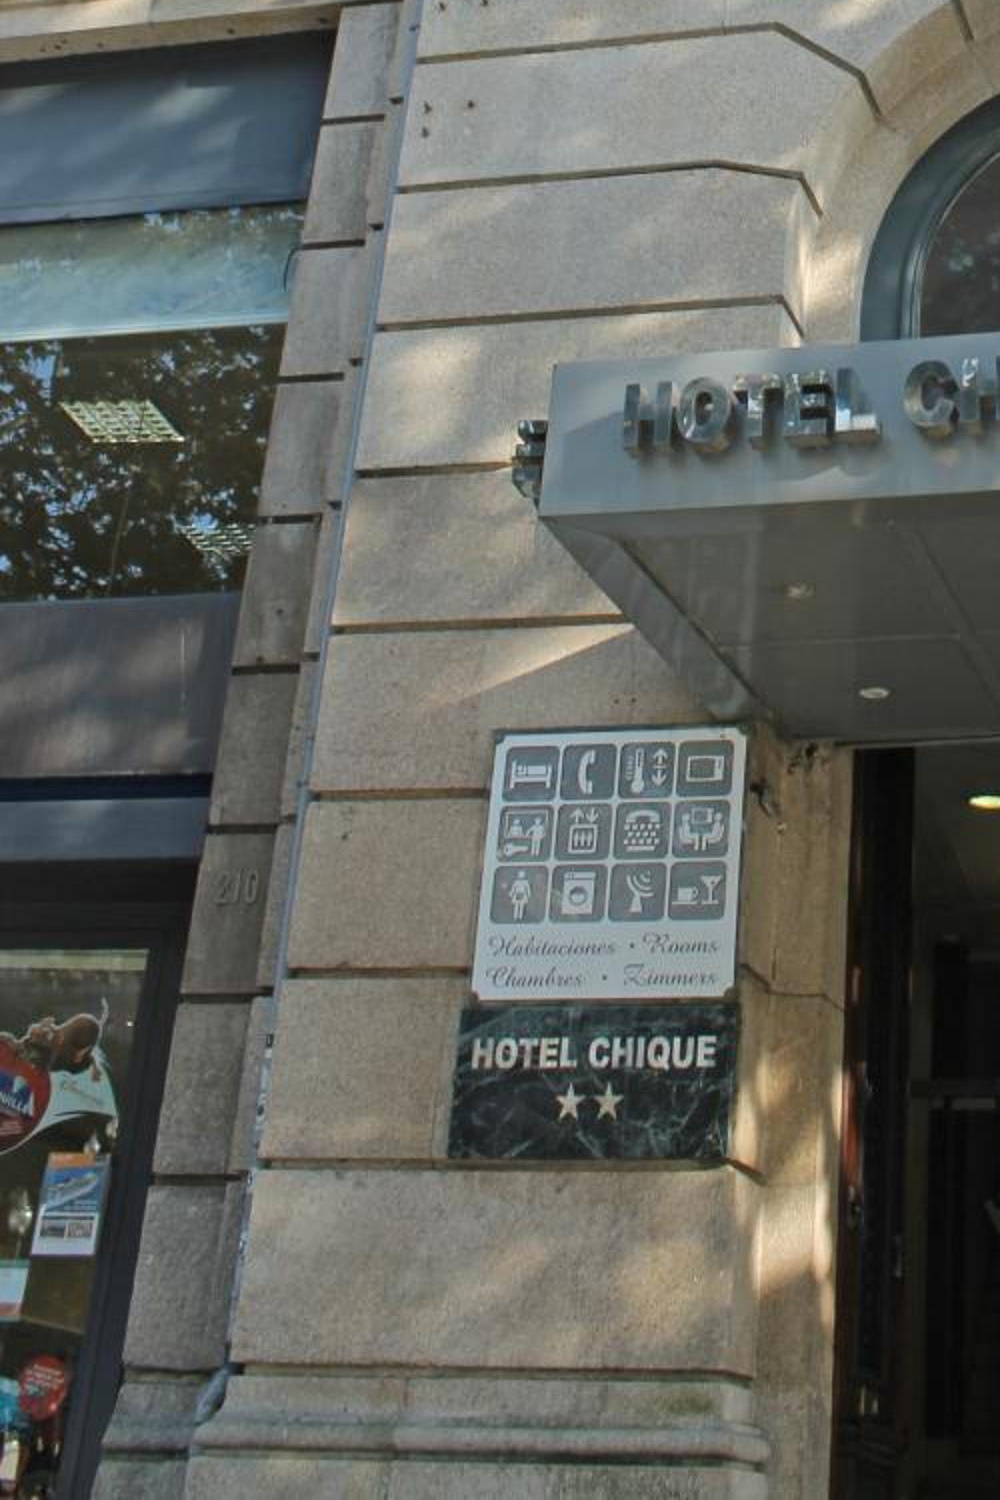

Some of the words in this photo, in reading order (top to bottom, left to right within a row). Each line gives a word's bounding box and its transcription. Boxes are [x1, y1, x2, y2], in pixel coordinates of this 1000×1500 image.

[623, 368, 880, 453] HOTEL
[488, 933, 617, 957] Habitaciones
[643, 931, 721, 955] Rooms
[485, 964, 585, 989] Chambres
[623, 963, 719, 987] Zimmers
[471, 1036, 577, 1070] HOTEL
[588, 1035, 718, 1071] CHIQUE
